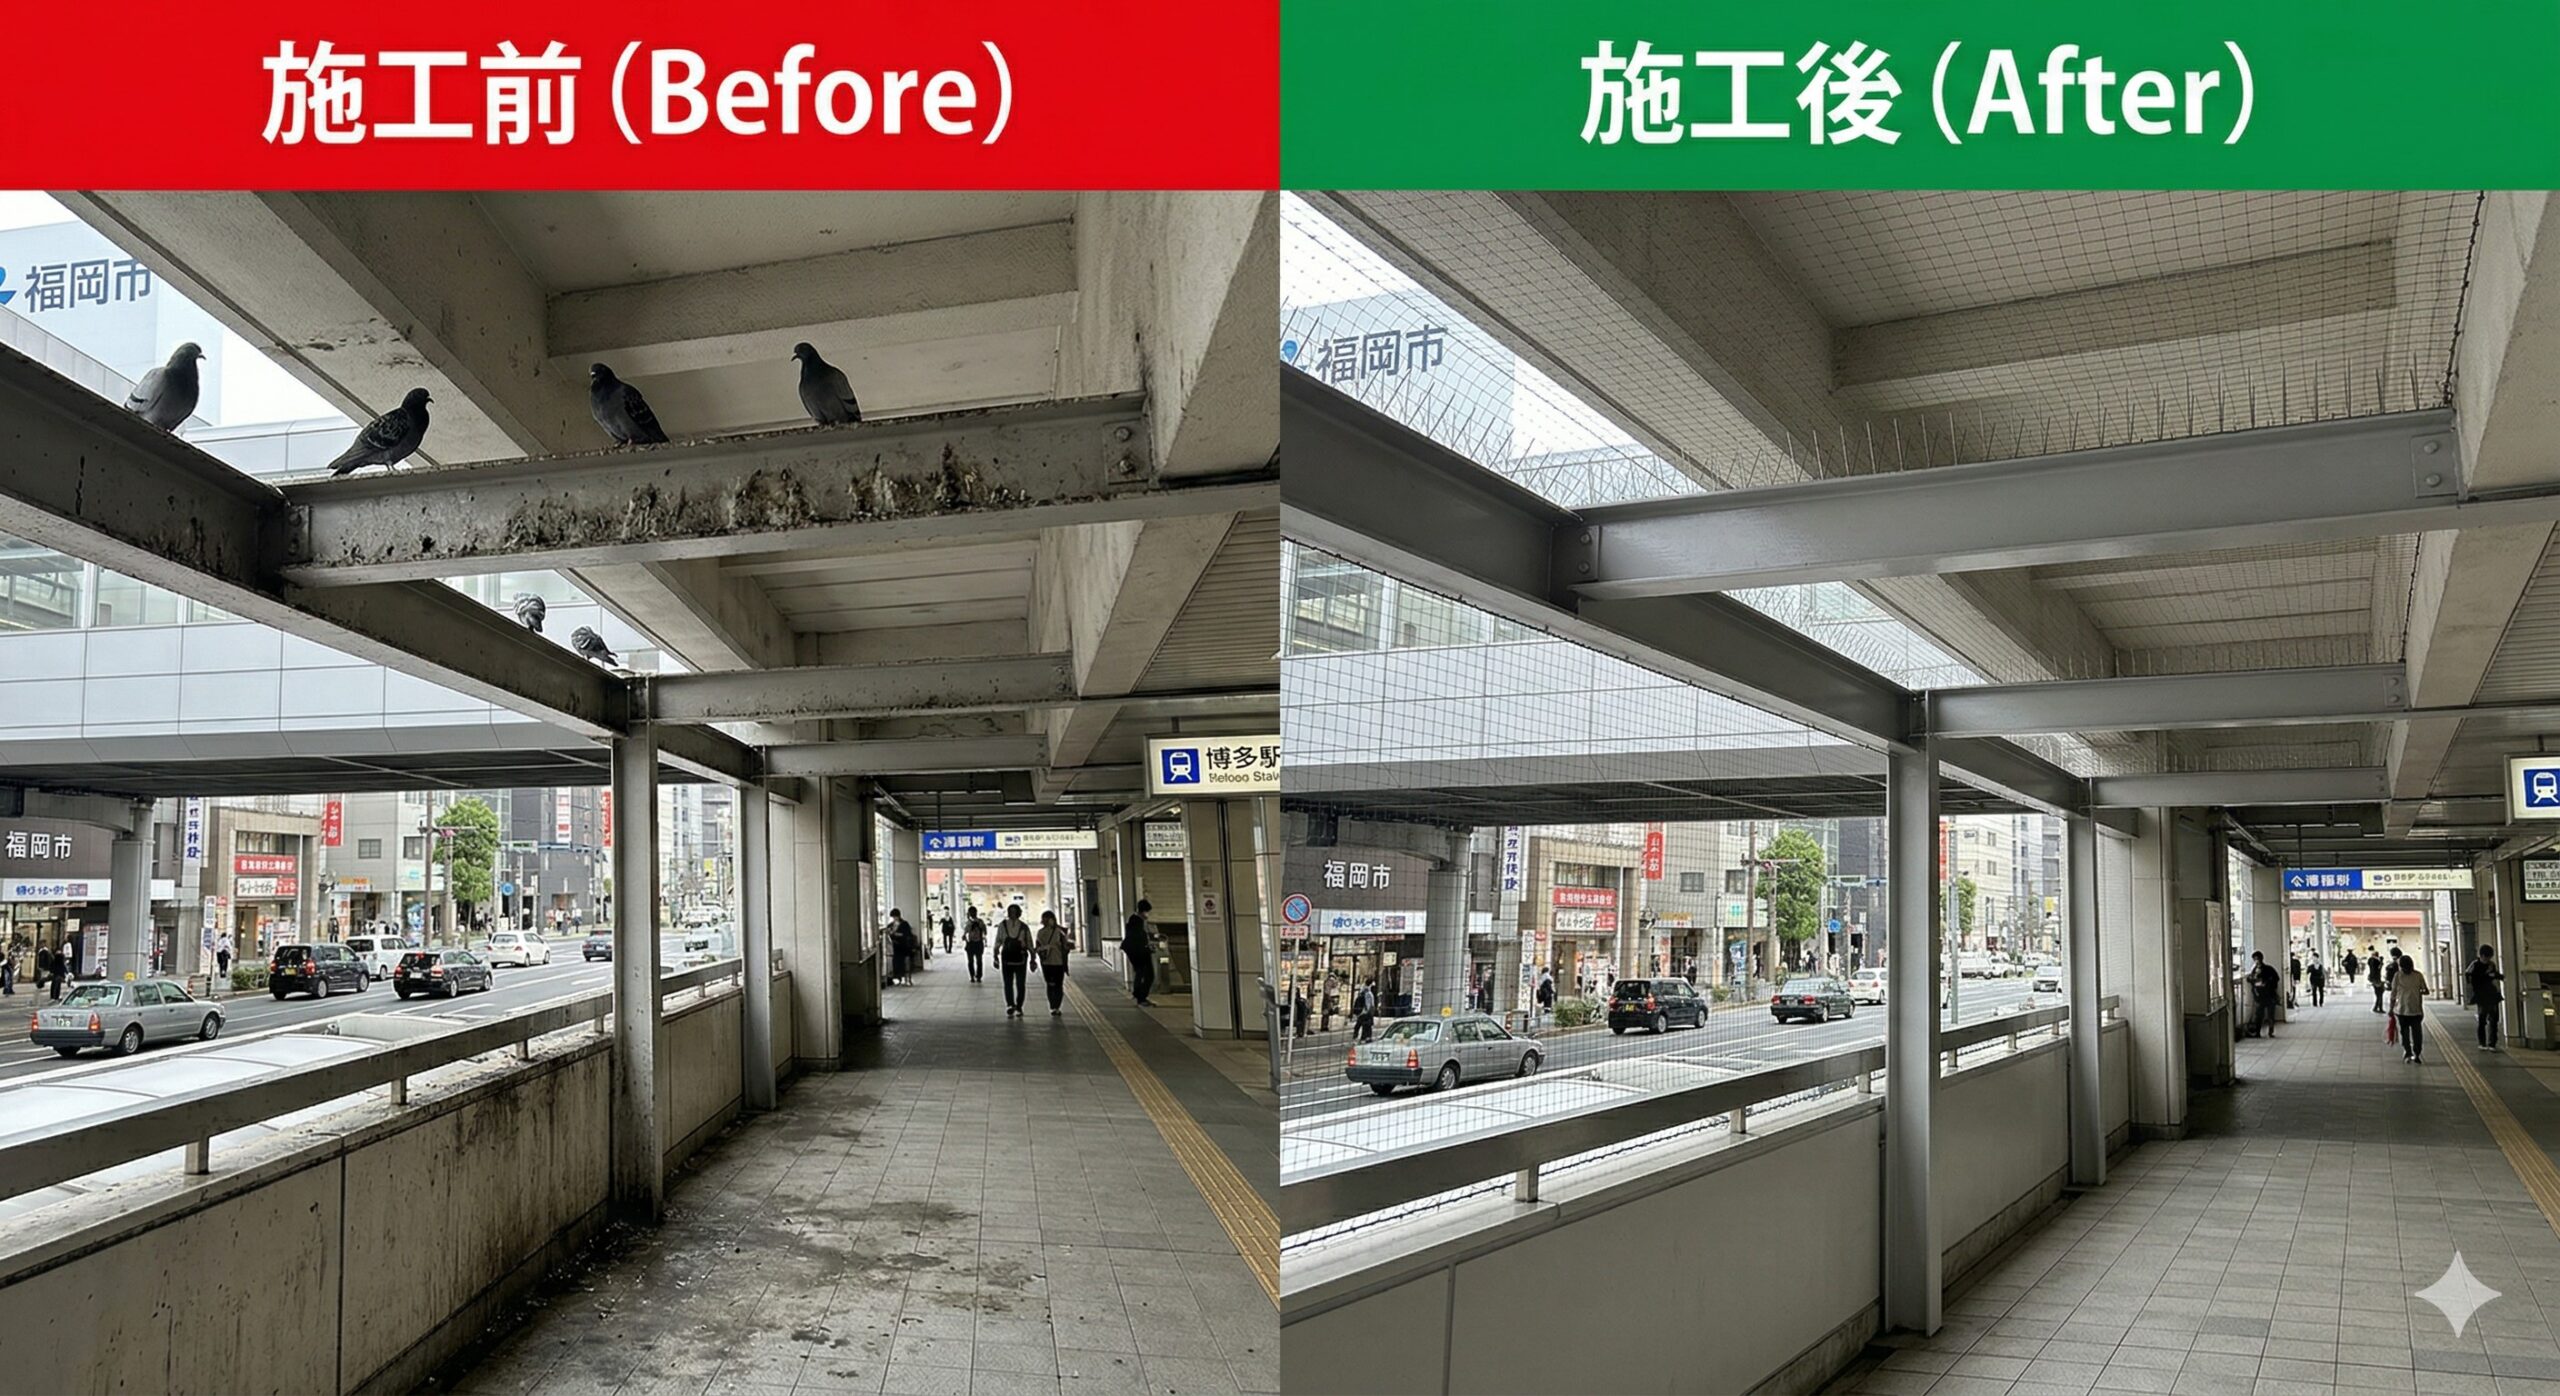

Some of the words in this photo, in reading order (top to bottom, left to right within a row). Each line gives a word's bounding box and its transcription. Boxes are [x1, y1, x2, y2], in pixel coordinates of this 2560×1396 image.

[25, 258, 151, 313] 福岡市
[1315, 324, 1448, 384] 福岡市
[1206, 746, 1280, 770] 博多駅
[6, 831, 72, 859] 福岡市
[1324, 859, 1391, 890] 福岡市
